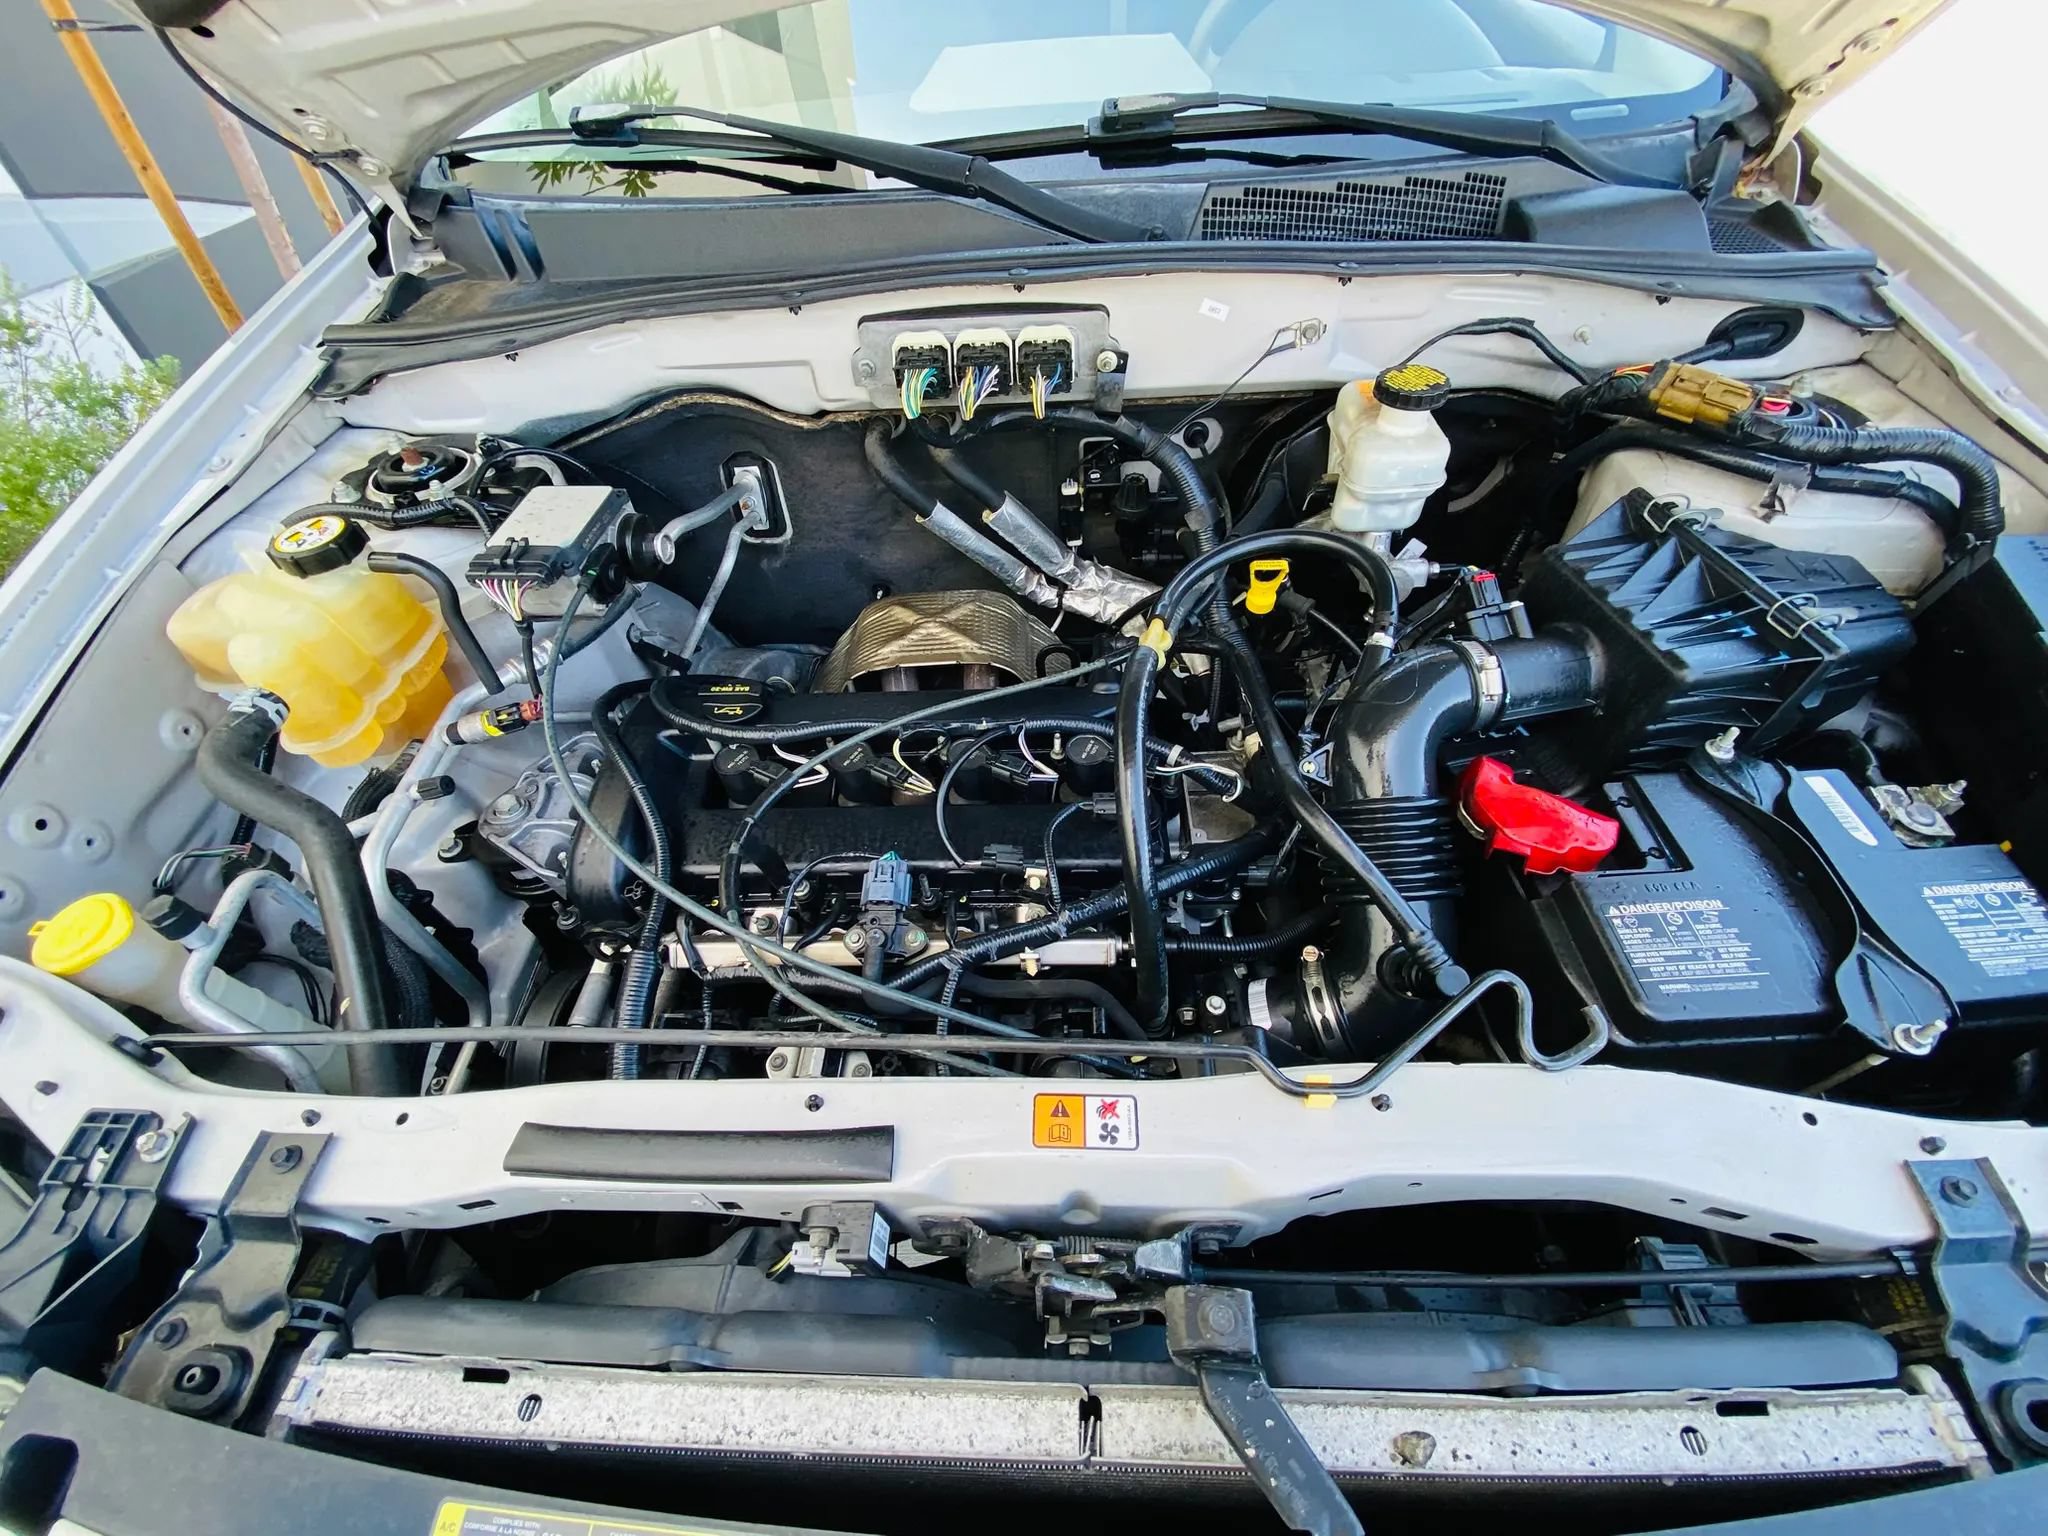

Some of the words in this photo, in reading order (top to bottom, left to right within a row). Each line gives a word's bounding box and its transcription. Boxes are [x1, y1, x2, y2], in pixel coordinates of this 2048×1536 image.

[1931, 881, 2029, 895] DANGER/POISON
[1618, 899, 1723, 914] DANGER/POISON
[439, 1521, 458, 1532] A/C
